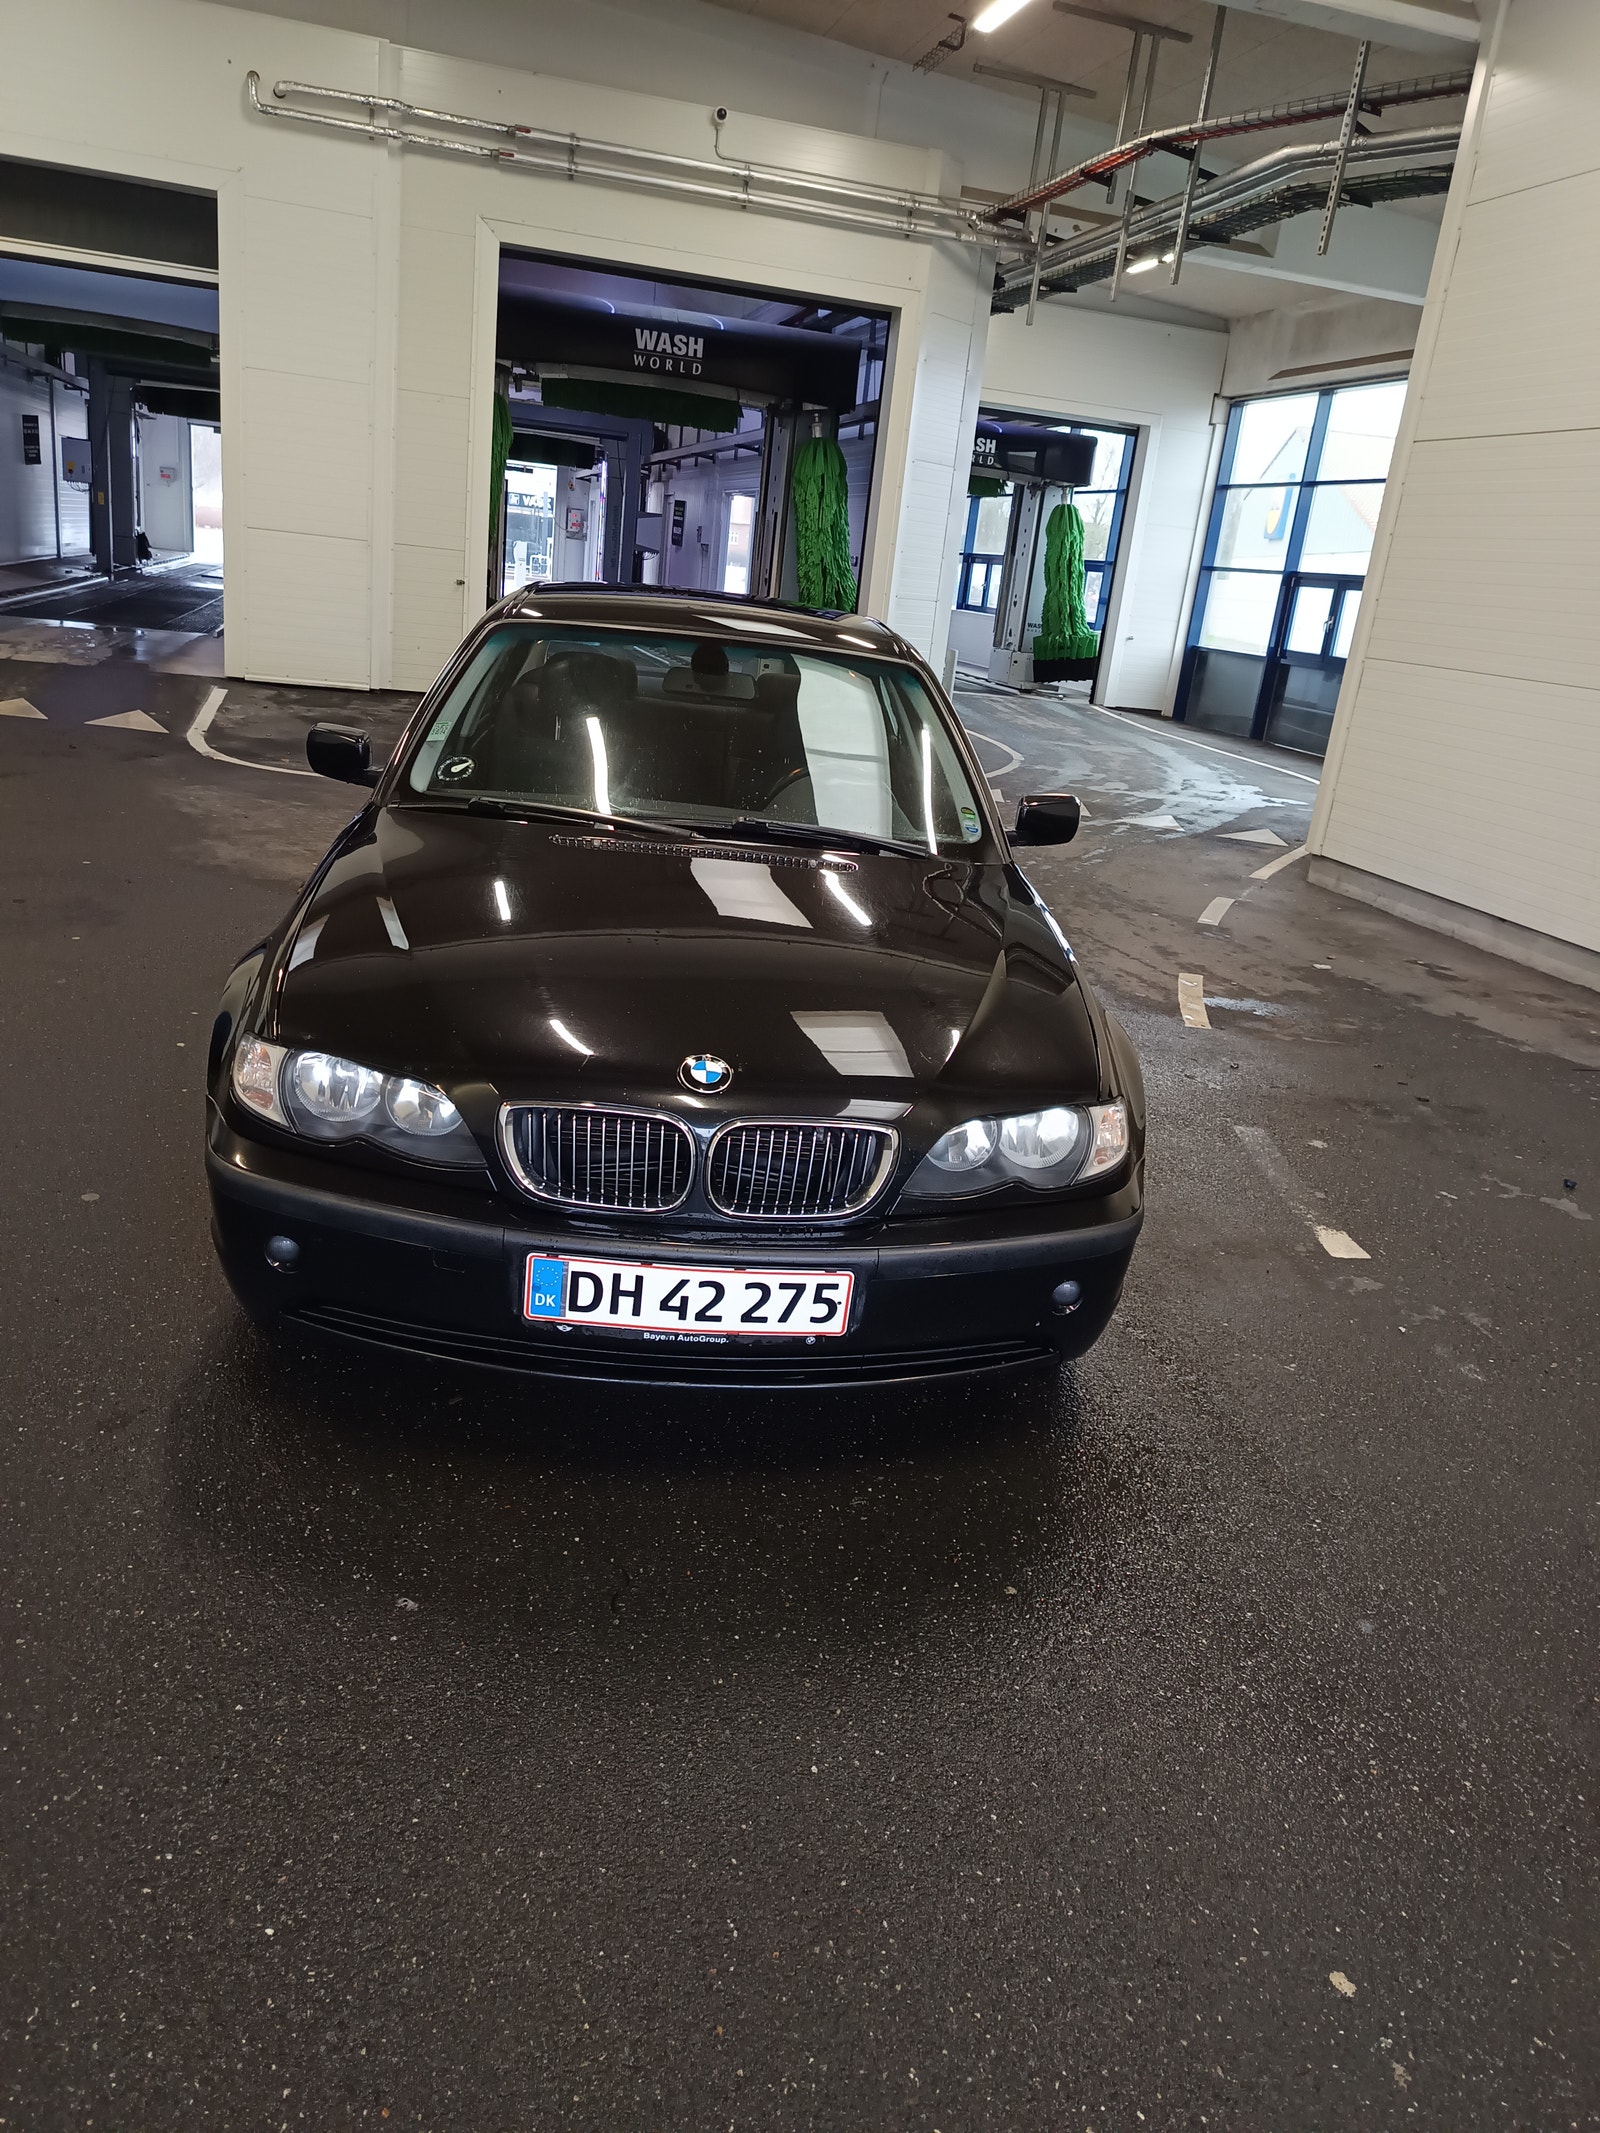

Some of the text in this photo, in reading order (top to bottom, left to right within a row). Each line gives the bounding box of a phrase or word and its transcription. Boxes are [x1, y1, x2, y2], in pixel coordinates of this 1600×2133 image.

[635, 328, 704, 358] WASH
[633, 354, 702, 375] WORLD
[973, 437, 997, 454] SH
[534, 1293, 556, 1307] DK
[568, 1270, 839, 1324] DH 42 275
